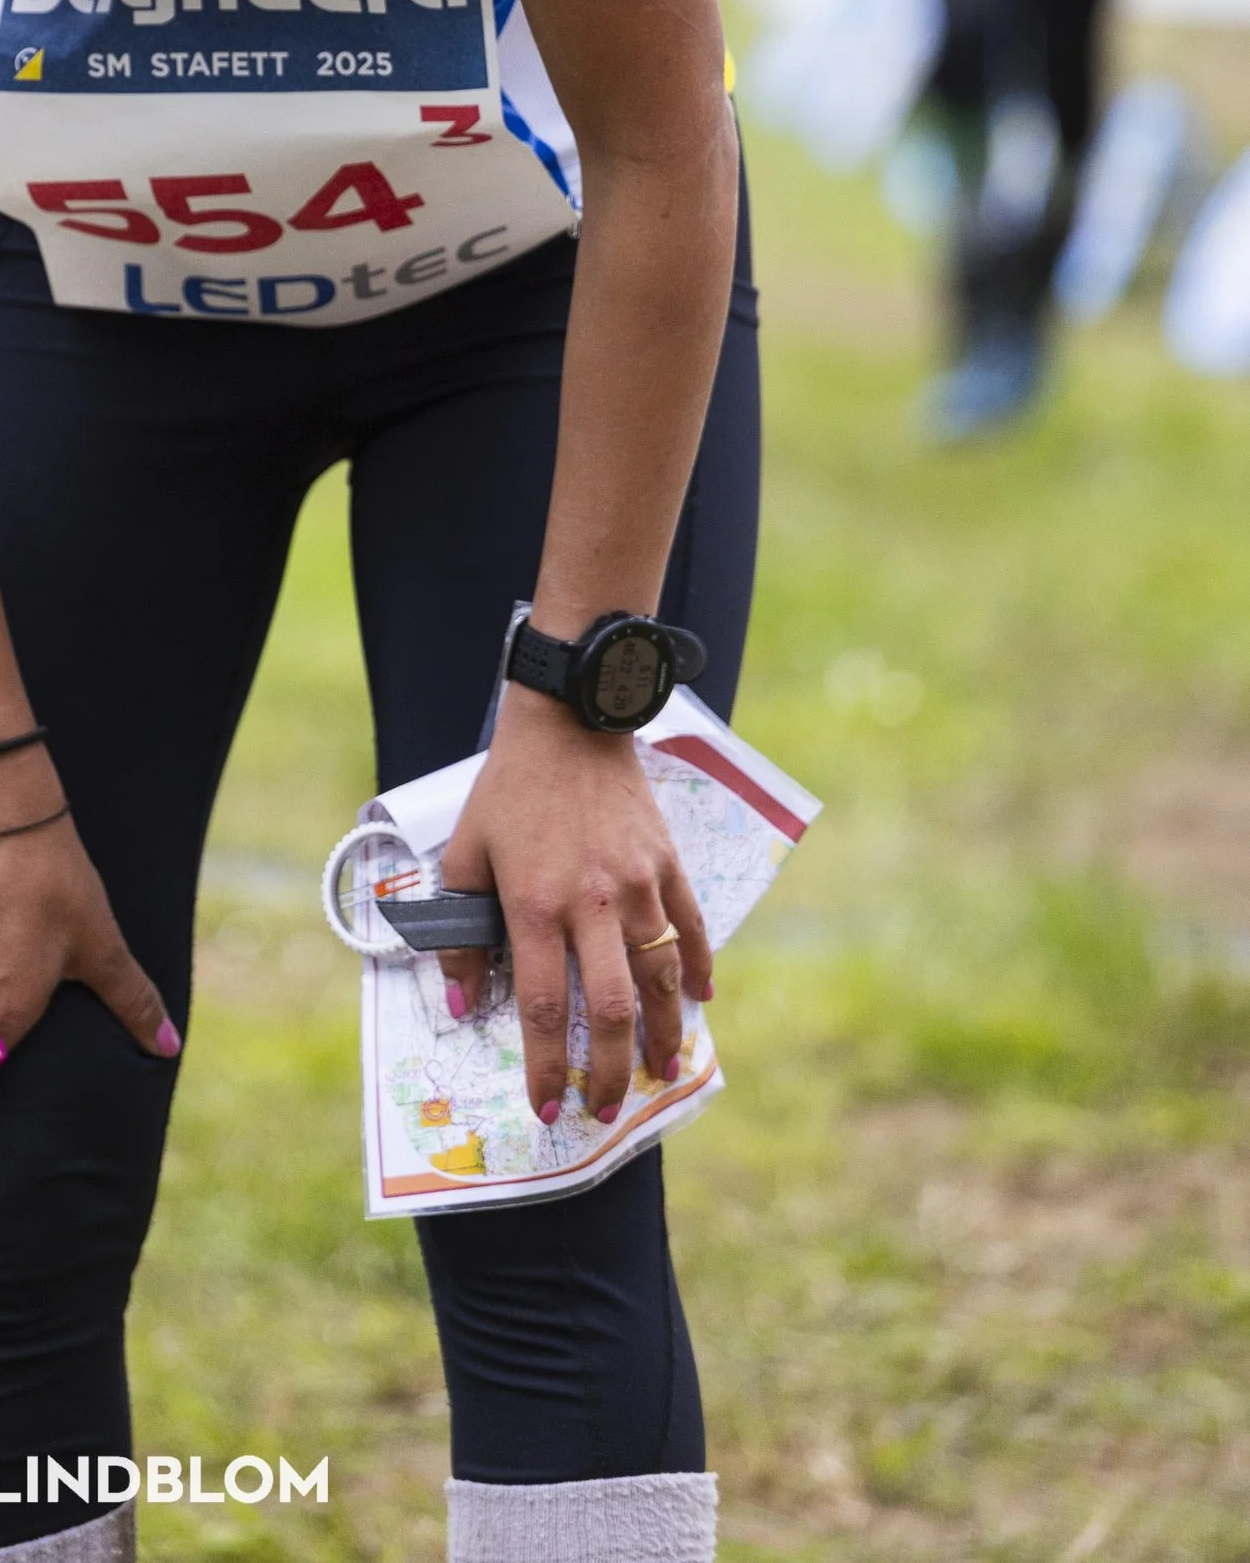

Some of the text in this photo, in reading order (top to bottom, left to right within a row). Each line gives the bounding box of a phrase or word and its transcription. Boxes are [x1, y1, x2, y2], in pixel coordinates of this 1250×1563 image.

[87, 51, 394, 78] SM STAFETT 2025
[419, 104, 493, 148] 3
[26, 160, 425, 255] 554
